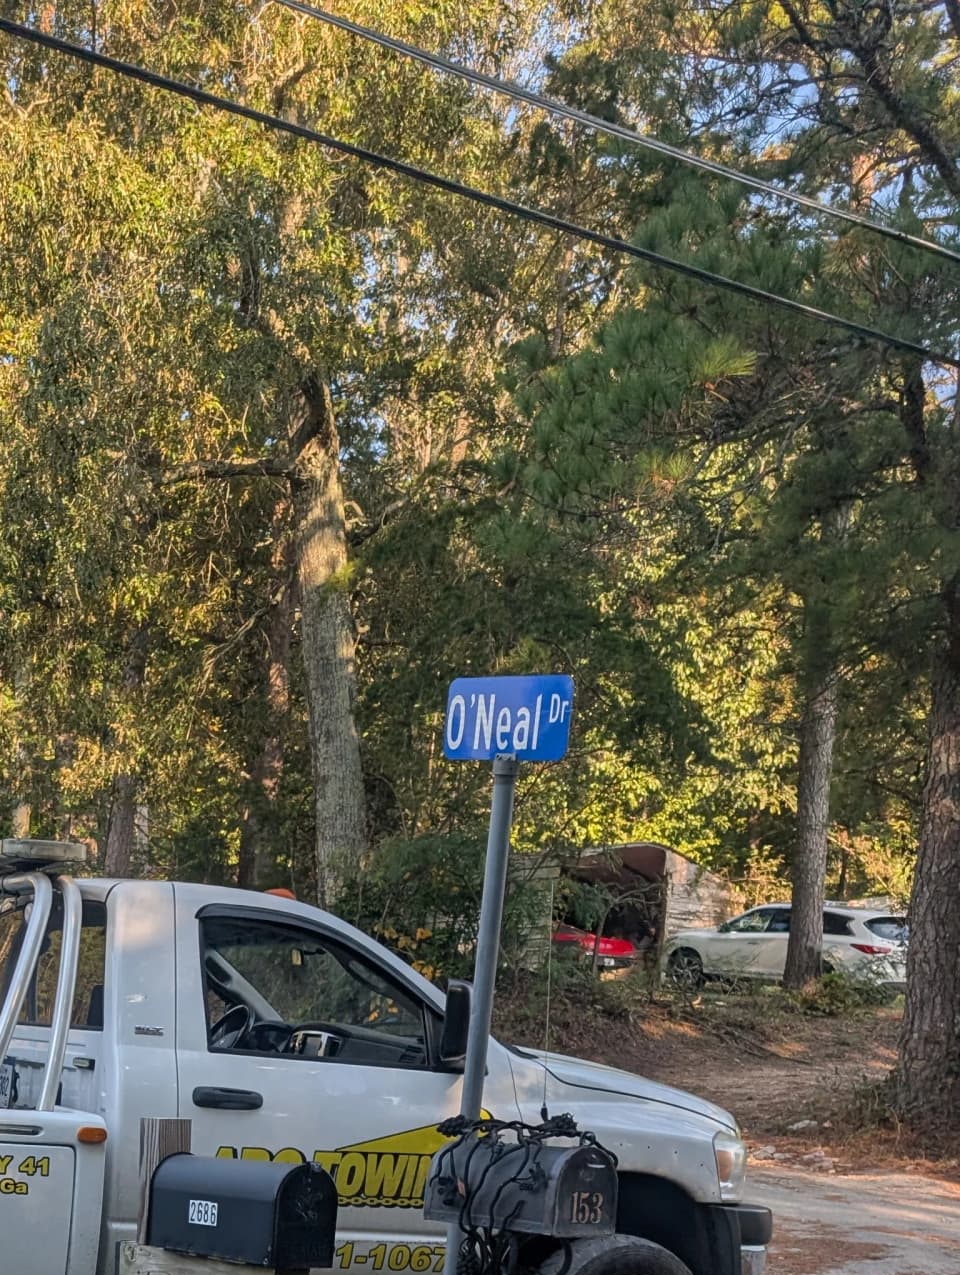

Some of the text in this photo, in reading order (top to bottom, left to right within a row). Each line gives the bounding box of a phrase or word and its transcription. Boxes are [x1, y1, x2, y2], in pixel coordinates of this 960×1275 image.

[446, 692, 570, 751] O'Neal Dr
[18, 1155, 50, 1177] 41
[190, 1201, 217, 1225] 2686
[571, 1191, 604, 1224] 153
